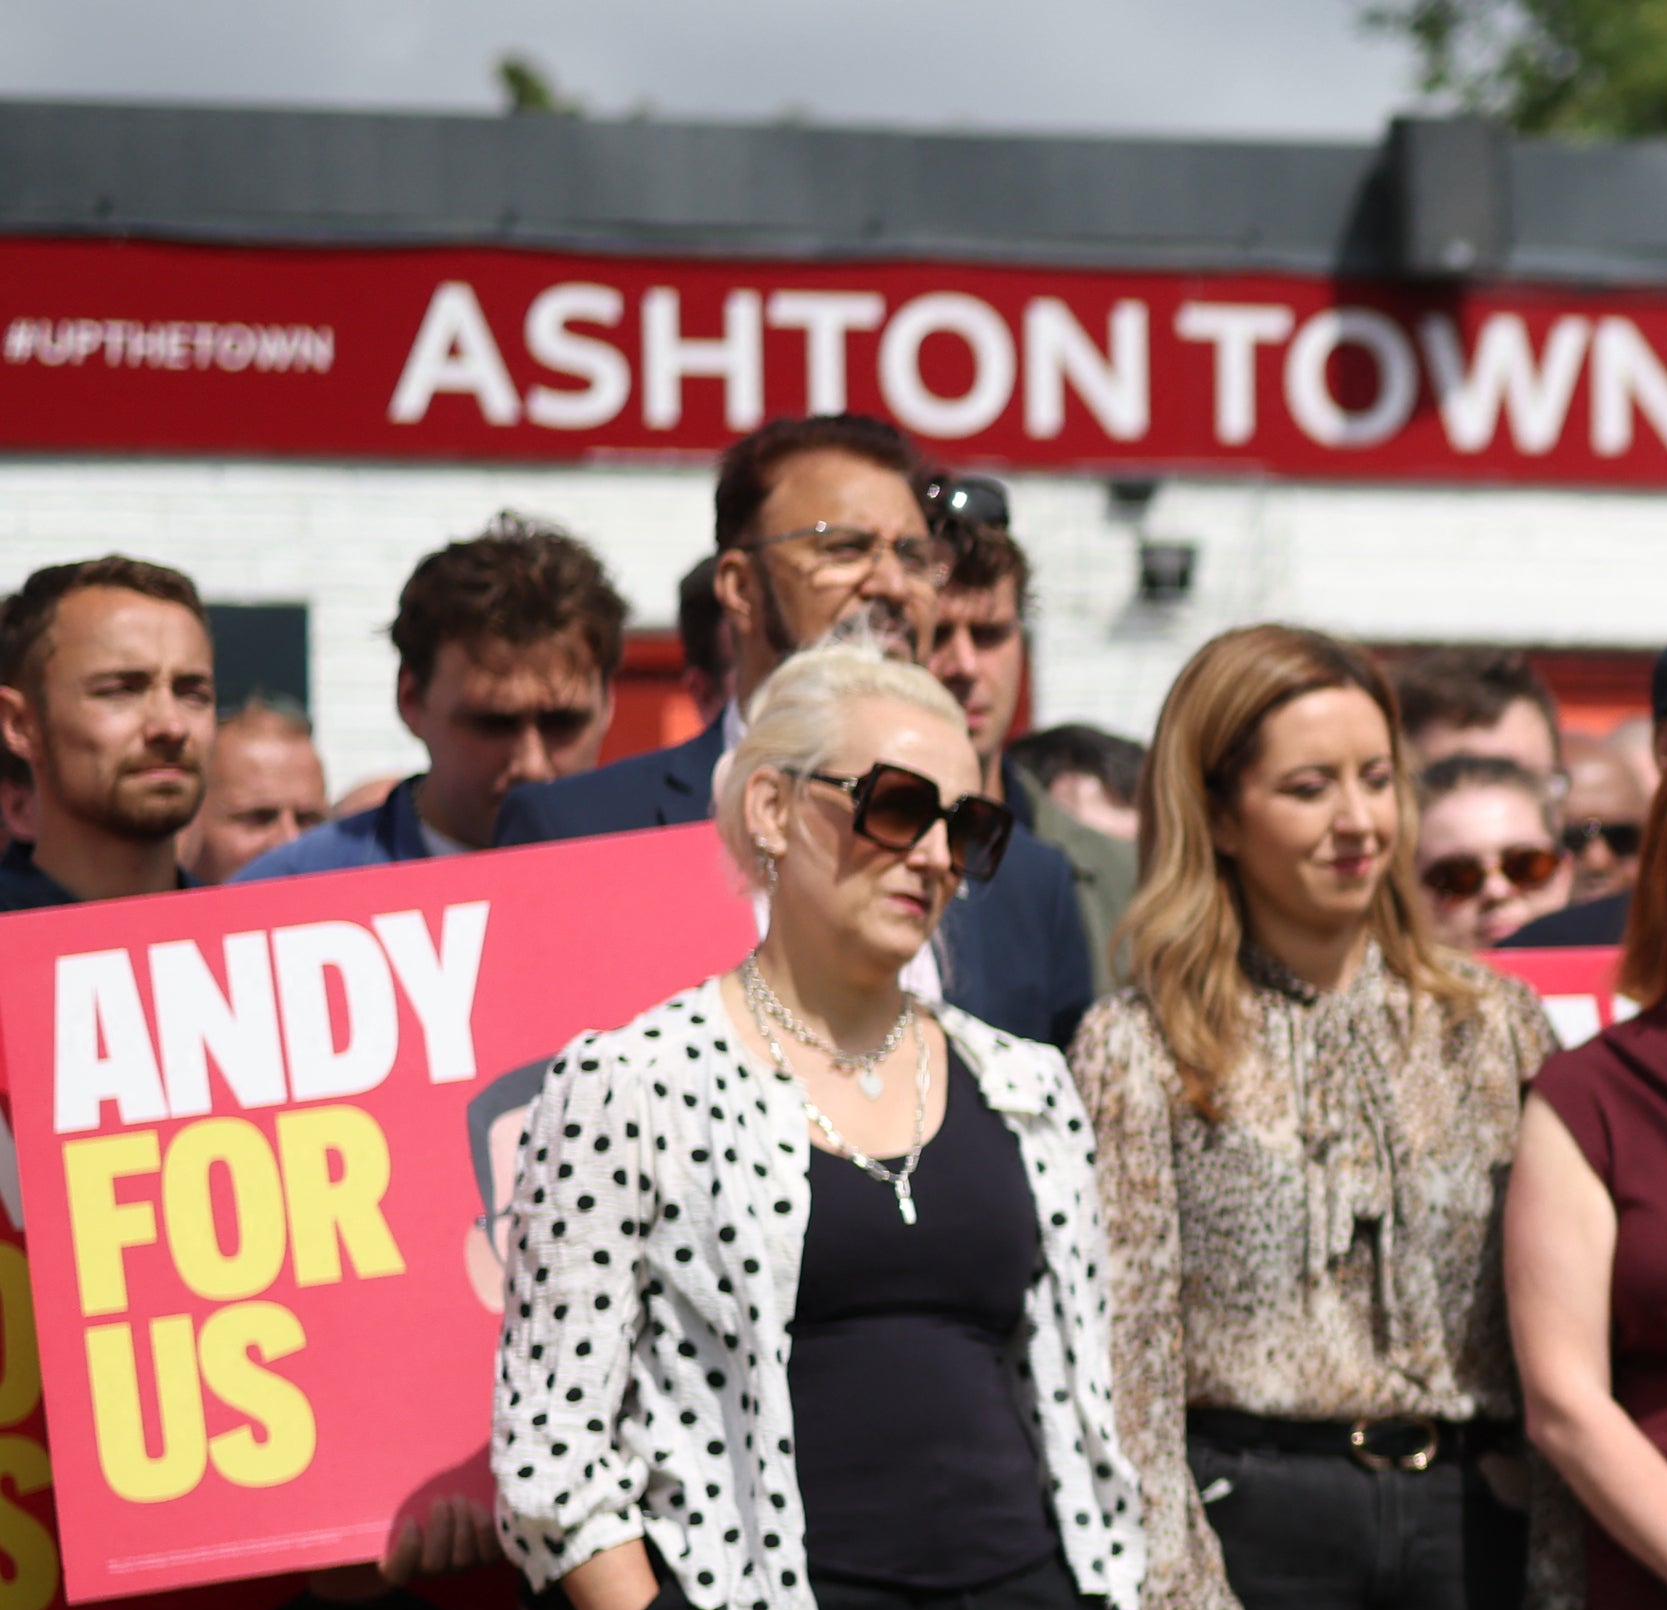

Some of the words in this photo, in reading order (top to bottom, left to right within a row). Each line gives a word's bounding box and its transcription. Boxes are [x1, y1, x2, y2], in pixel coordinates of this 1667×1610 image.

[4, 317, 335, 374] #UPTHETOWN
[388, 281, 1151, 443] ASHTON
[53, 900, 490, 1134] ANDY
[62, 1105, 405, 1316] FOR
[84, 1301, 316, 1504] US
